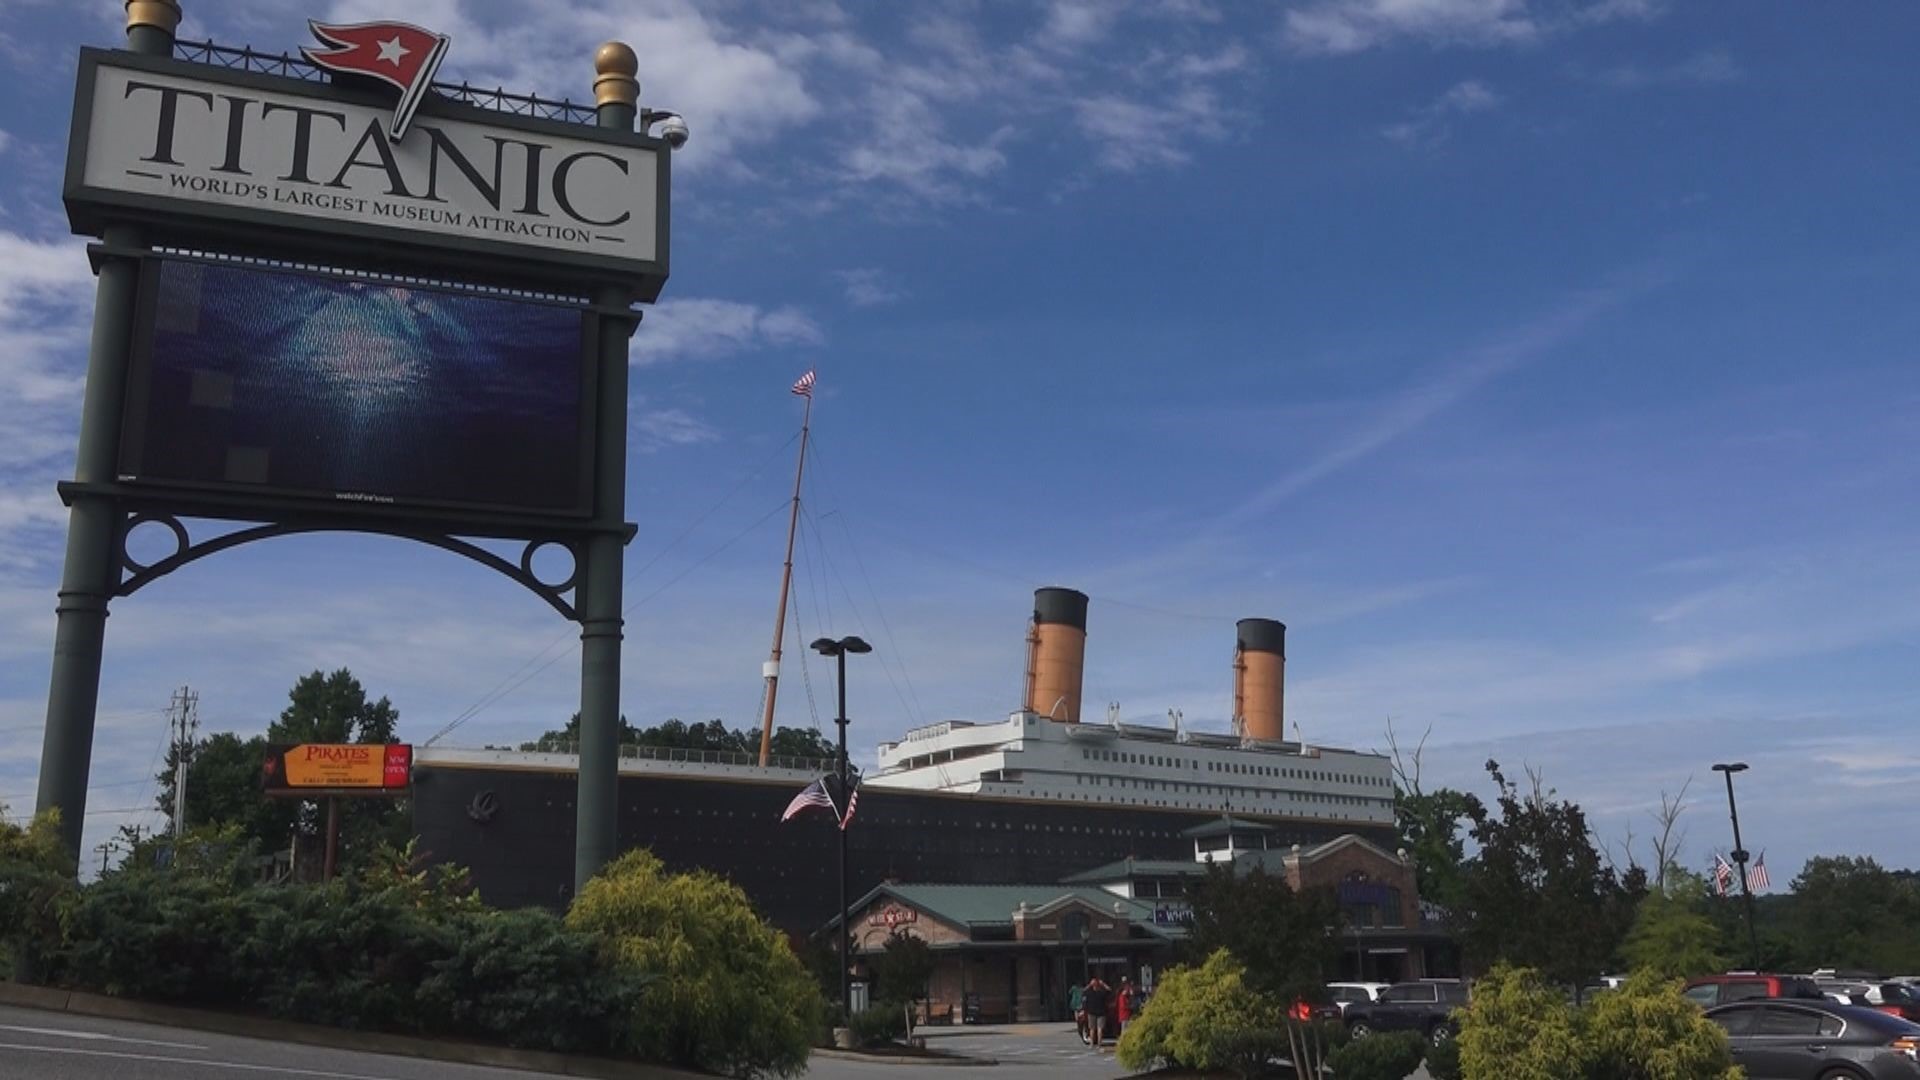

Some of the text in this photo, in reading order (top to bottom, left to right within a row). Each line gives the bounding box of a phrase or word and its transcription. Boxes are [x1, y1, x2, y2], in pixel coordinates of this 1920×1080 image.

[124, 80, 631, 227] TITANIC
[169, 173, 591, 244] WORLD'S LARGEST MUSEUM ATTRACTION
[305, 746, 369, 762] PIRATES
